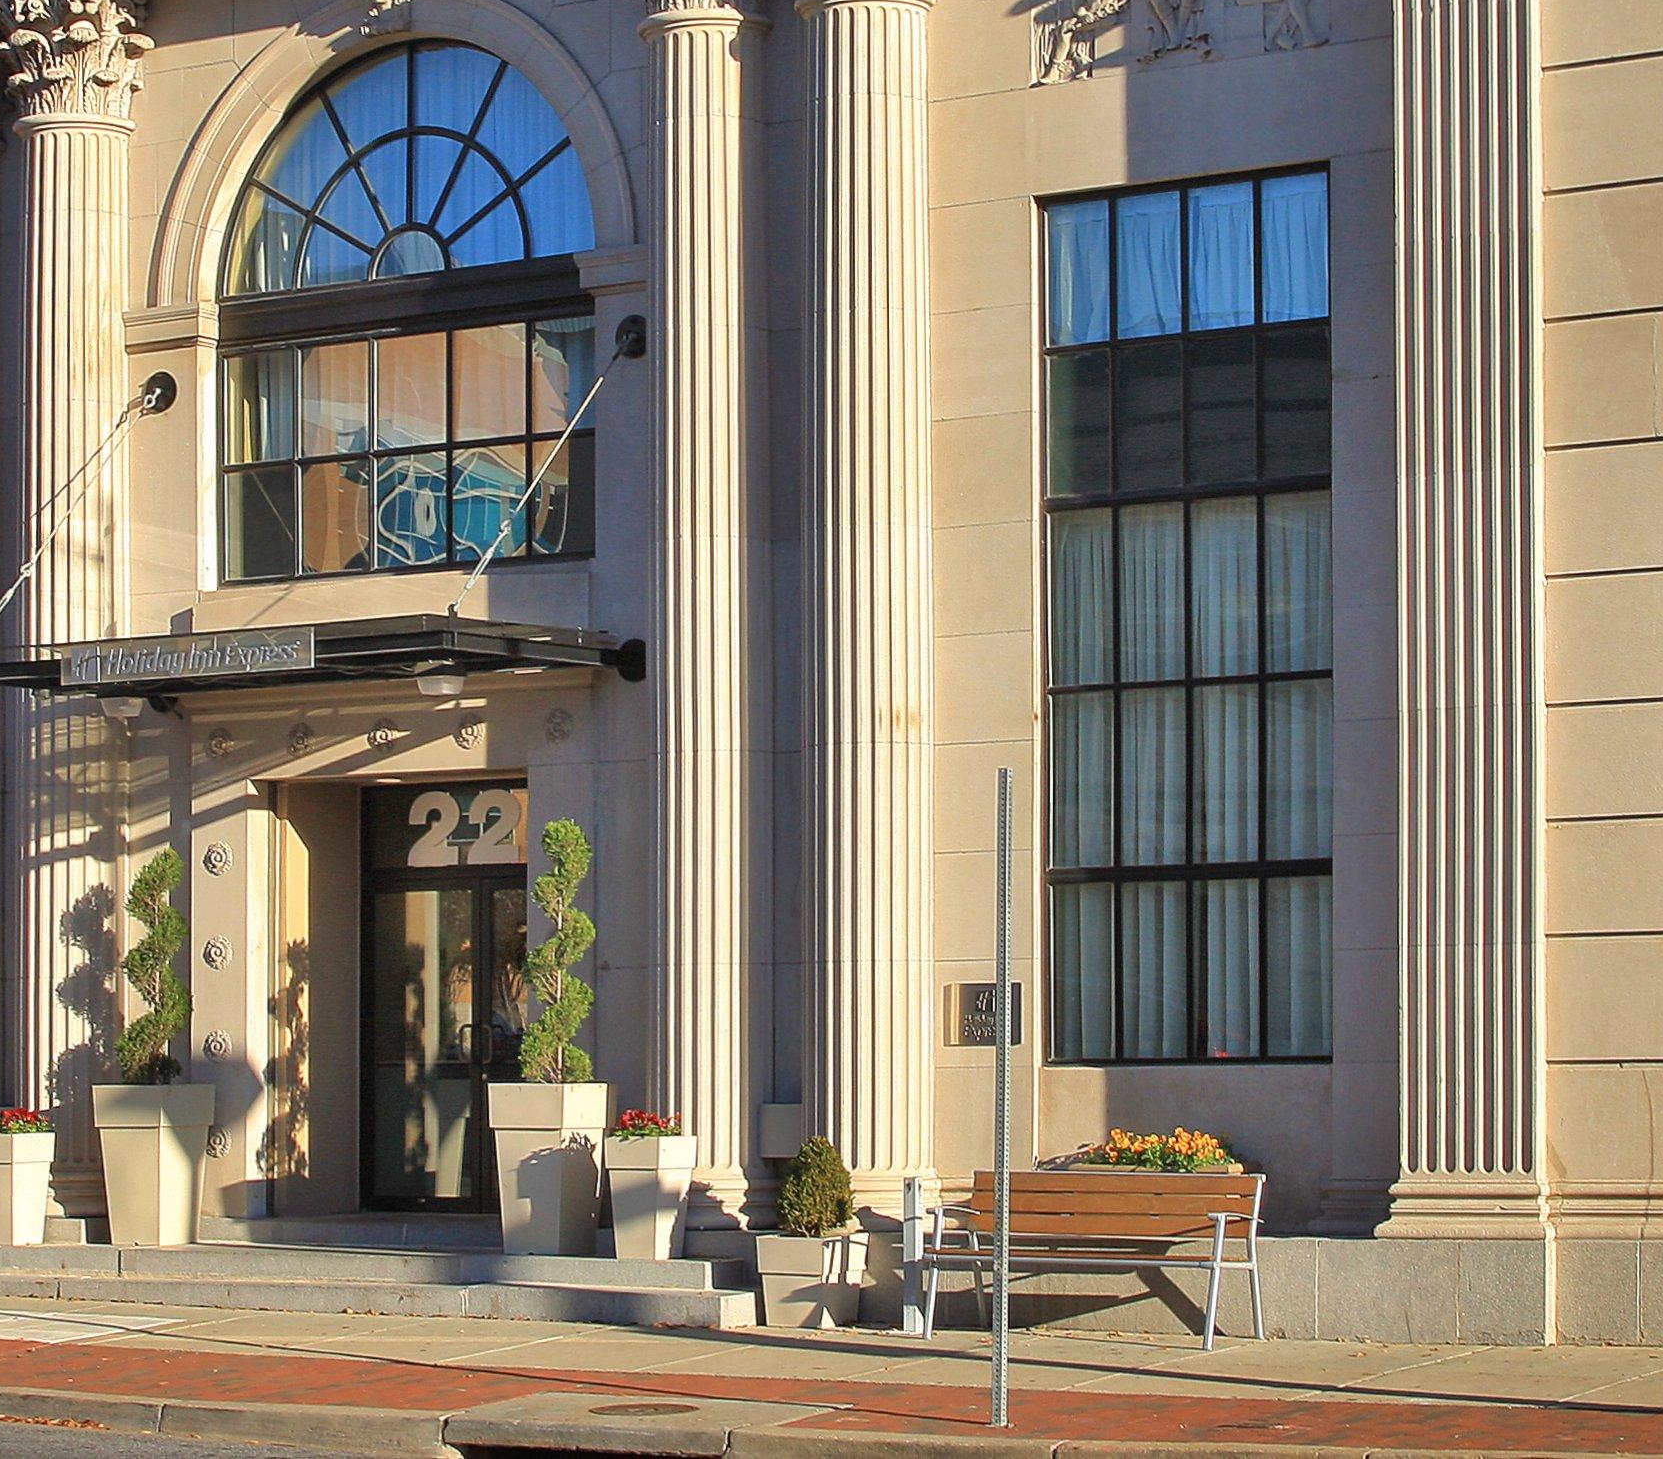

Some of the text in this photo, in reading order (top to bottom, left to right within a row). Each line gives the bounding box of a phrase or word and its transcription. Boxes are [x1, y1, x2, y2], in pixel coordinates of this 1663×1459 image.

[107, 641, 298, 676] Holiday Inn Express
[407, 789, 521, 868] 22
